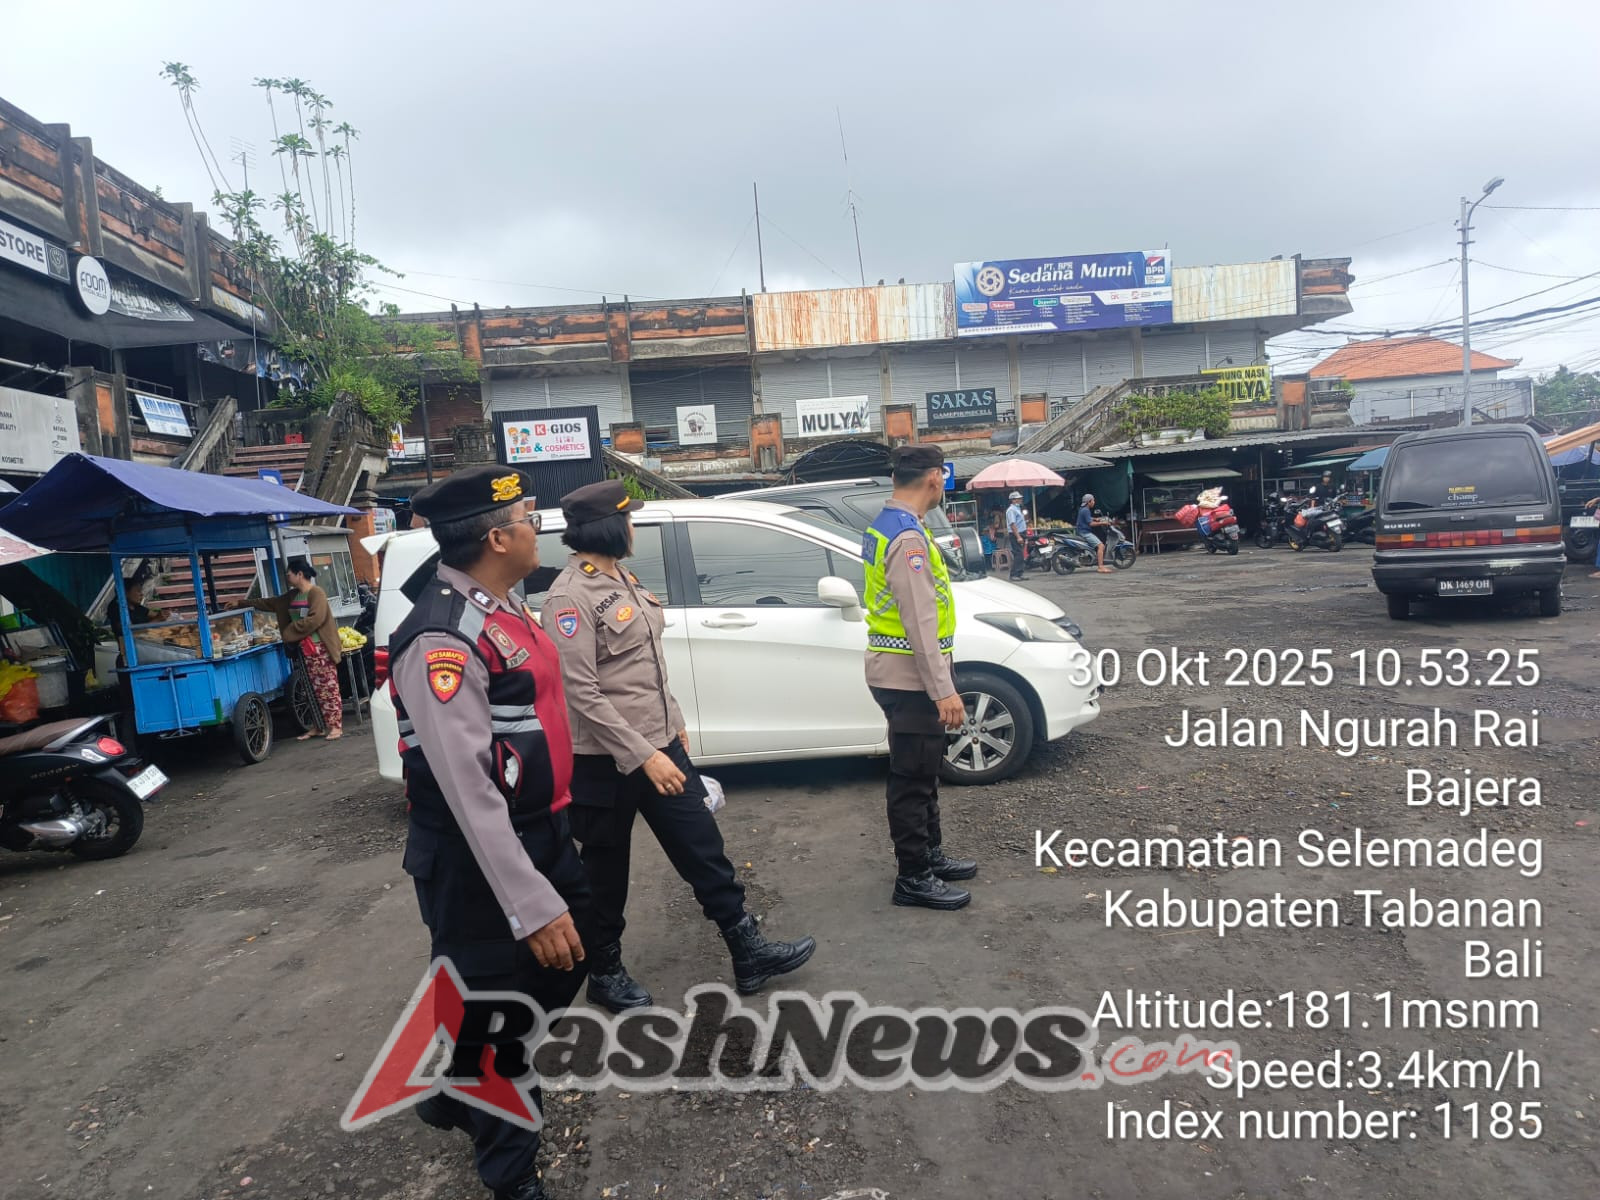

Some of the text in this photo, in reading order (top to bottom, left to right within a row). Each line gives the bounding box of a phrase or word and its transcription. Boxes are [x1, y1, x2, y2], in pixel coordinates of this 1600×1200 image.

[0, 229, 45, 263] STORE
[1008, 261, 1133, 284] Sedana Murni
[1145, 266, 1164, 275] BPR
[80, 271, 107, 294] FOOM
[1244, 368, 1264, 378] NASI
[931, 390, 993, 410] SARAS
[801, 411, 862, 432] MULYA
[534, 442, 543, 453] &
[545, 443, 585, 452] COSMETICS
[1447, 494, 1478, 502] champ
[1440, 581, 1453, 590] DK
[1456, 580, 1474, 589] 1469
[595, 591, 621, 614] DESAK
